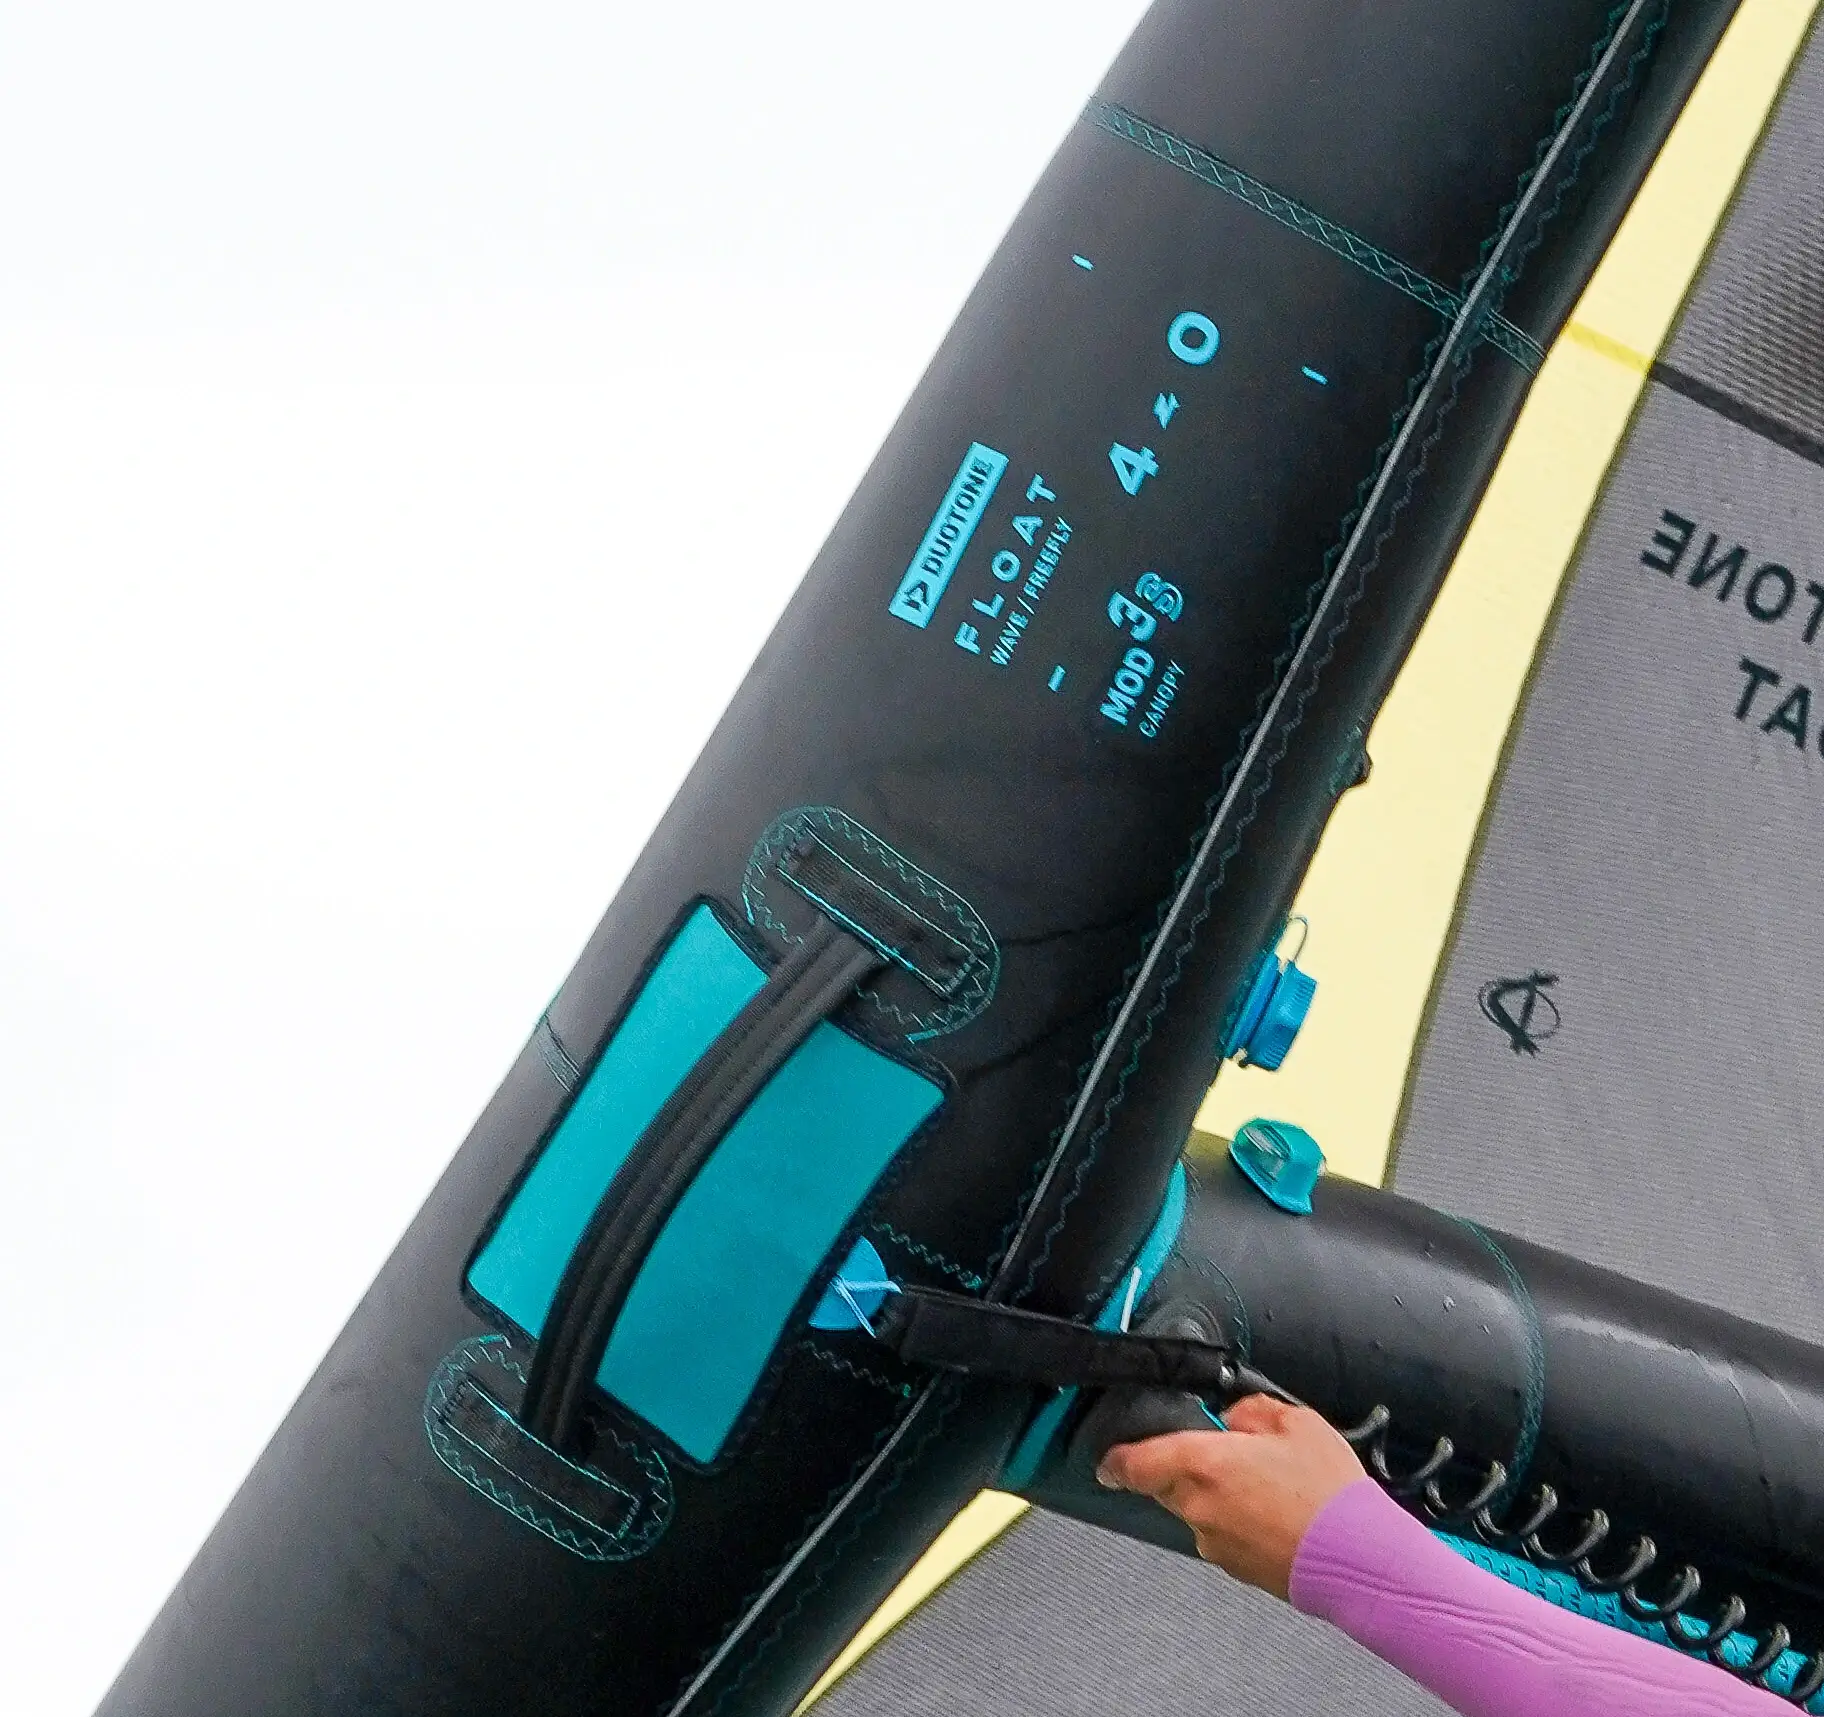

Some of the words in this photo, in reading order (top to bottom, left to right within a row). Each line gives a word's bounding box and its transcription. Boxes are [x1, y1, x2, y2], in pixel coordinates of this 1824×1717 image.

[922, 456, 995, 578] DUOTONE
[954, 473, 1058, 655] FLOAT
[990, 612, 1030, 665] WAVE
[1139, 659, 1185, 738] CANOPY
